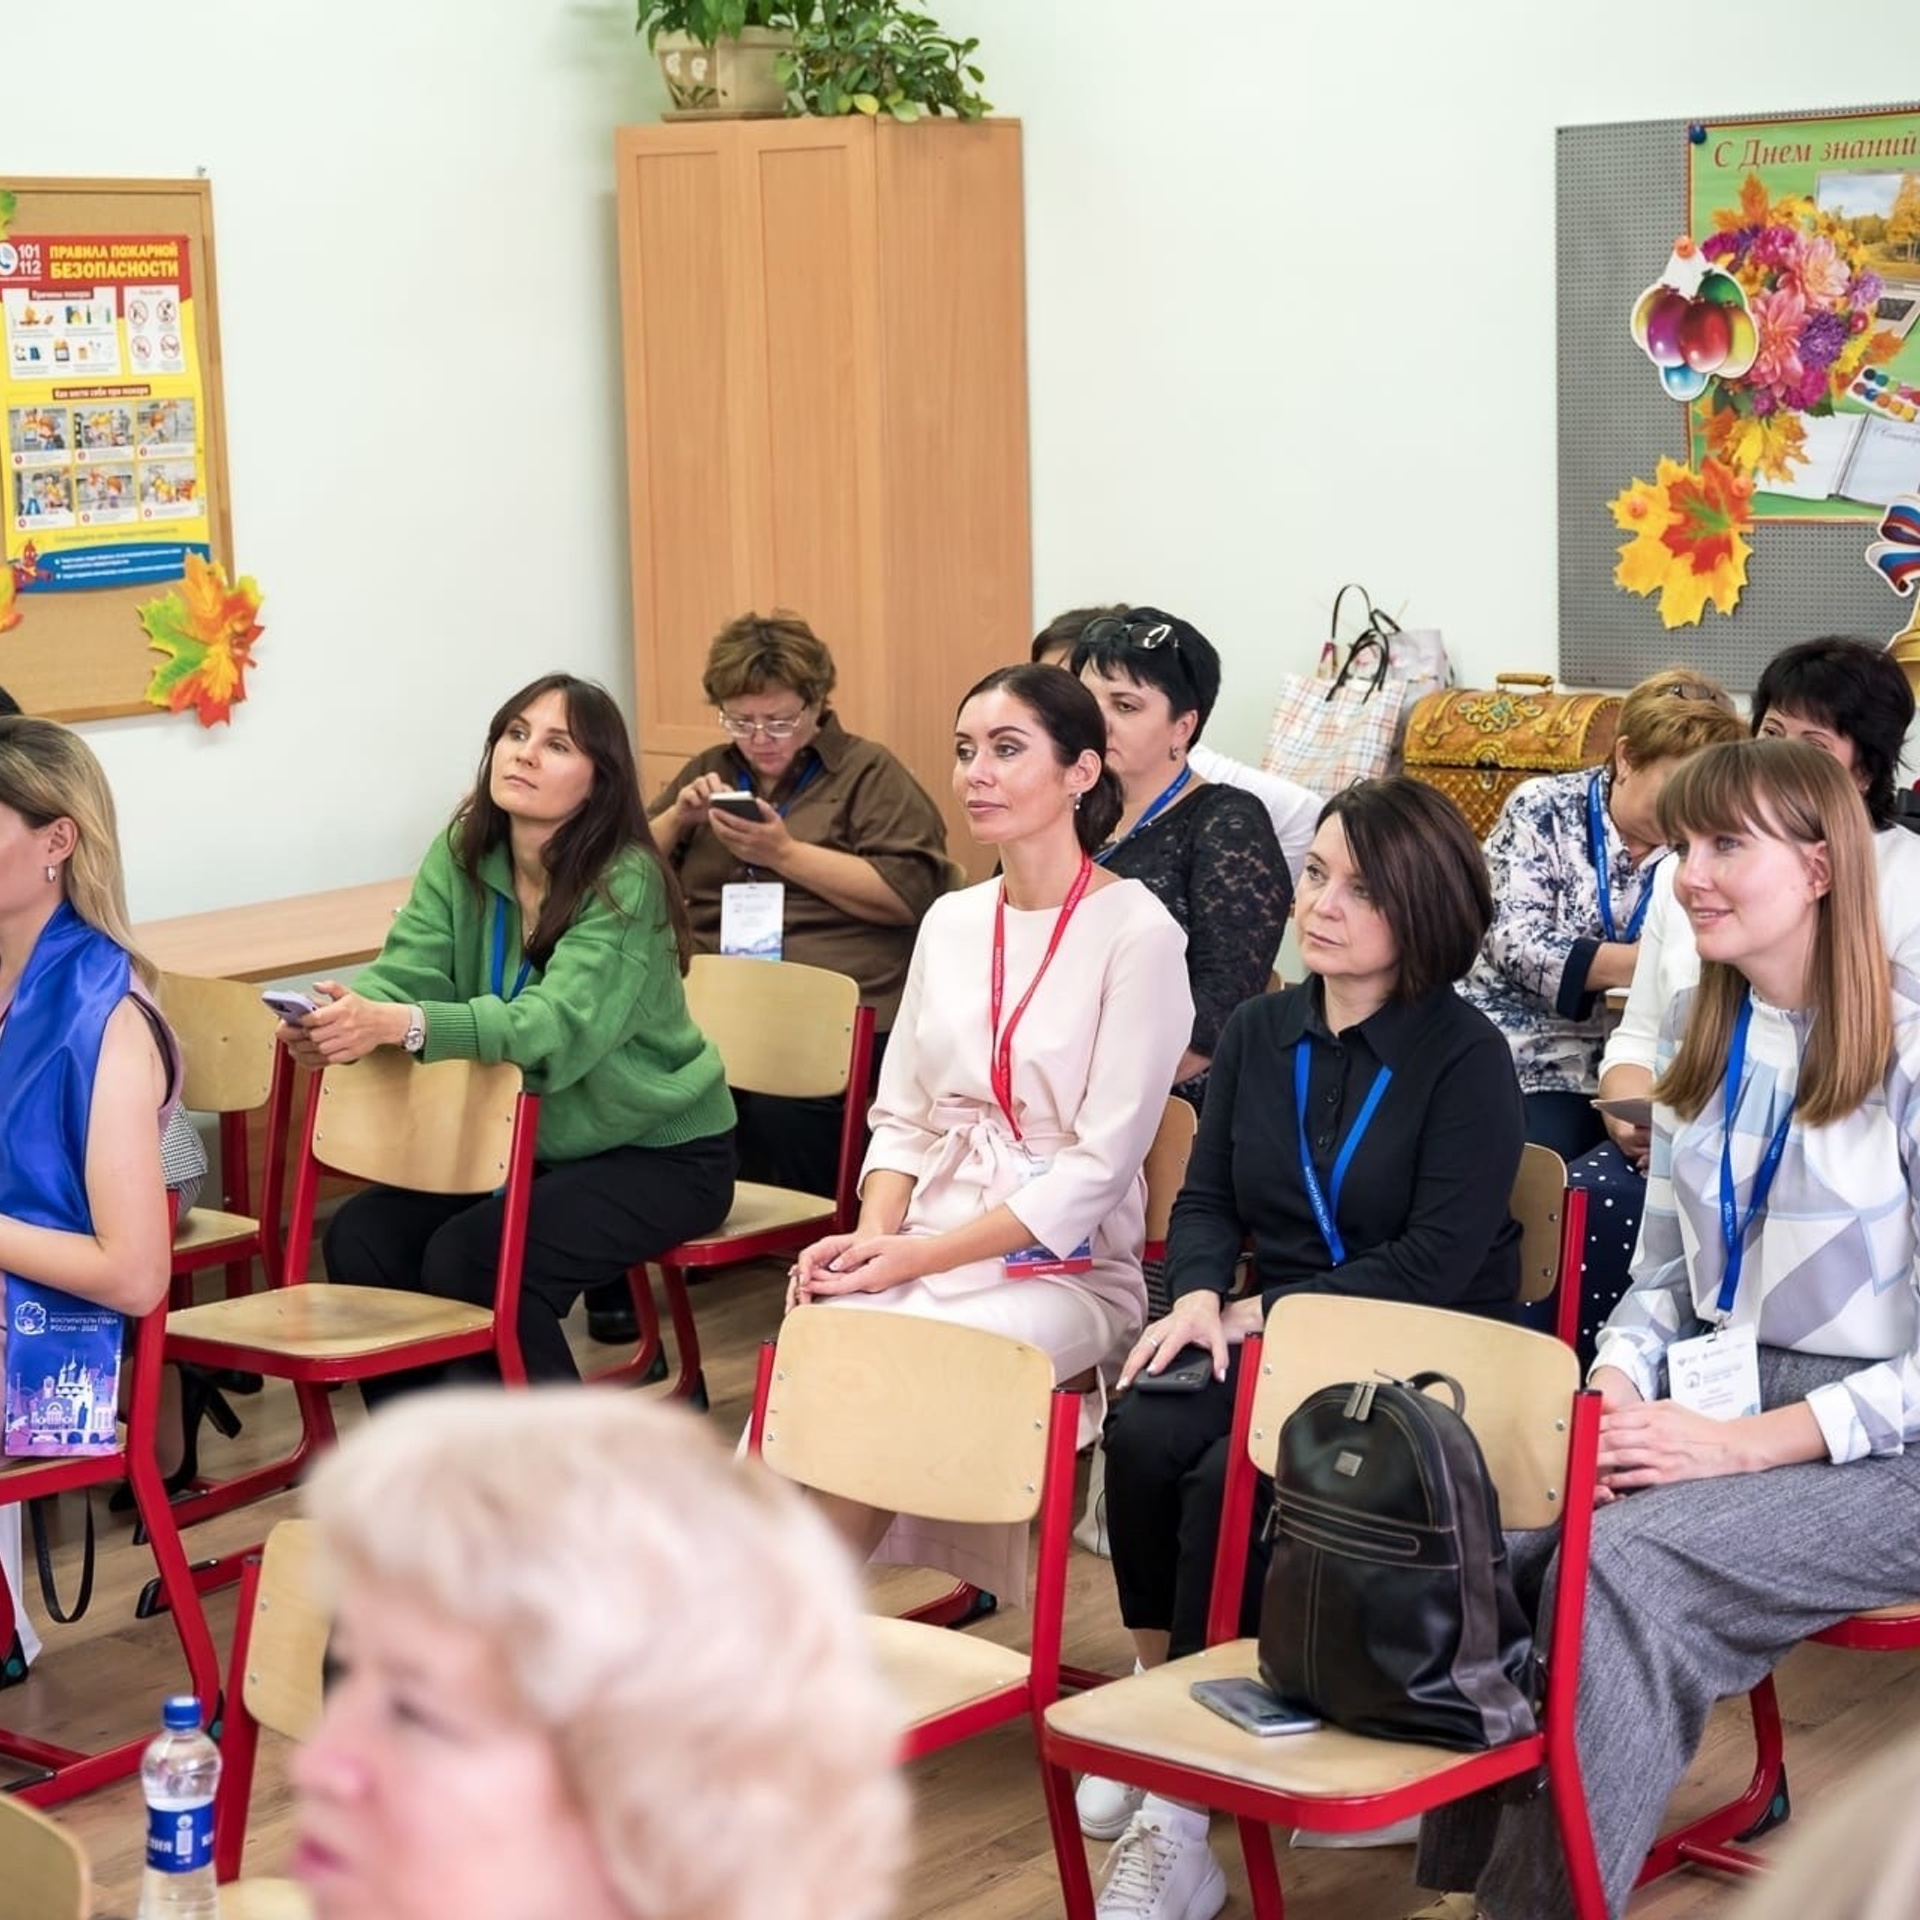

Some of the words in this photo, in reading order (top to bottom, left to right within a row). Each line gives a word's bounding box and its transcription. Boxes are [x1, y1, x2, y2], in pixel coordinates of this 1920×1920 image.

[1714, 140, 1733, 168] С
[1738, 138, 1812, 171] Днем
[18, 243, 40, 259] 101
[50, 245, 108, 259] ПРАВИЛА
[111, 241, 179, 259] ПОЖАРНОЙ
[19, 260, 41, 275] 112
[51, 260, 179, 279] БЕЗОПАСНОСТИ
